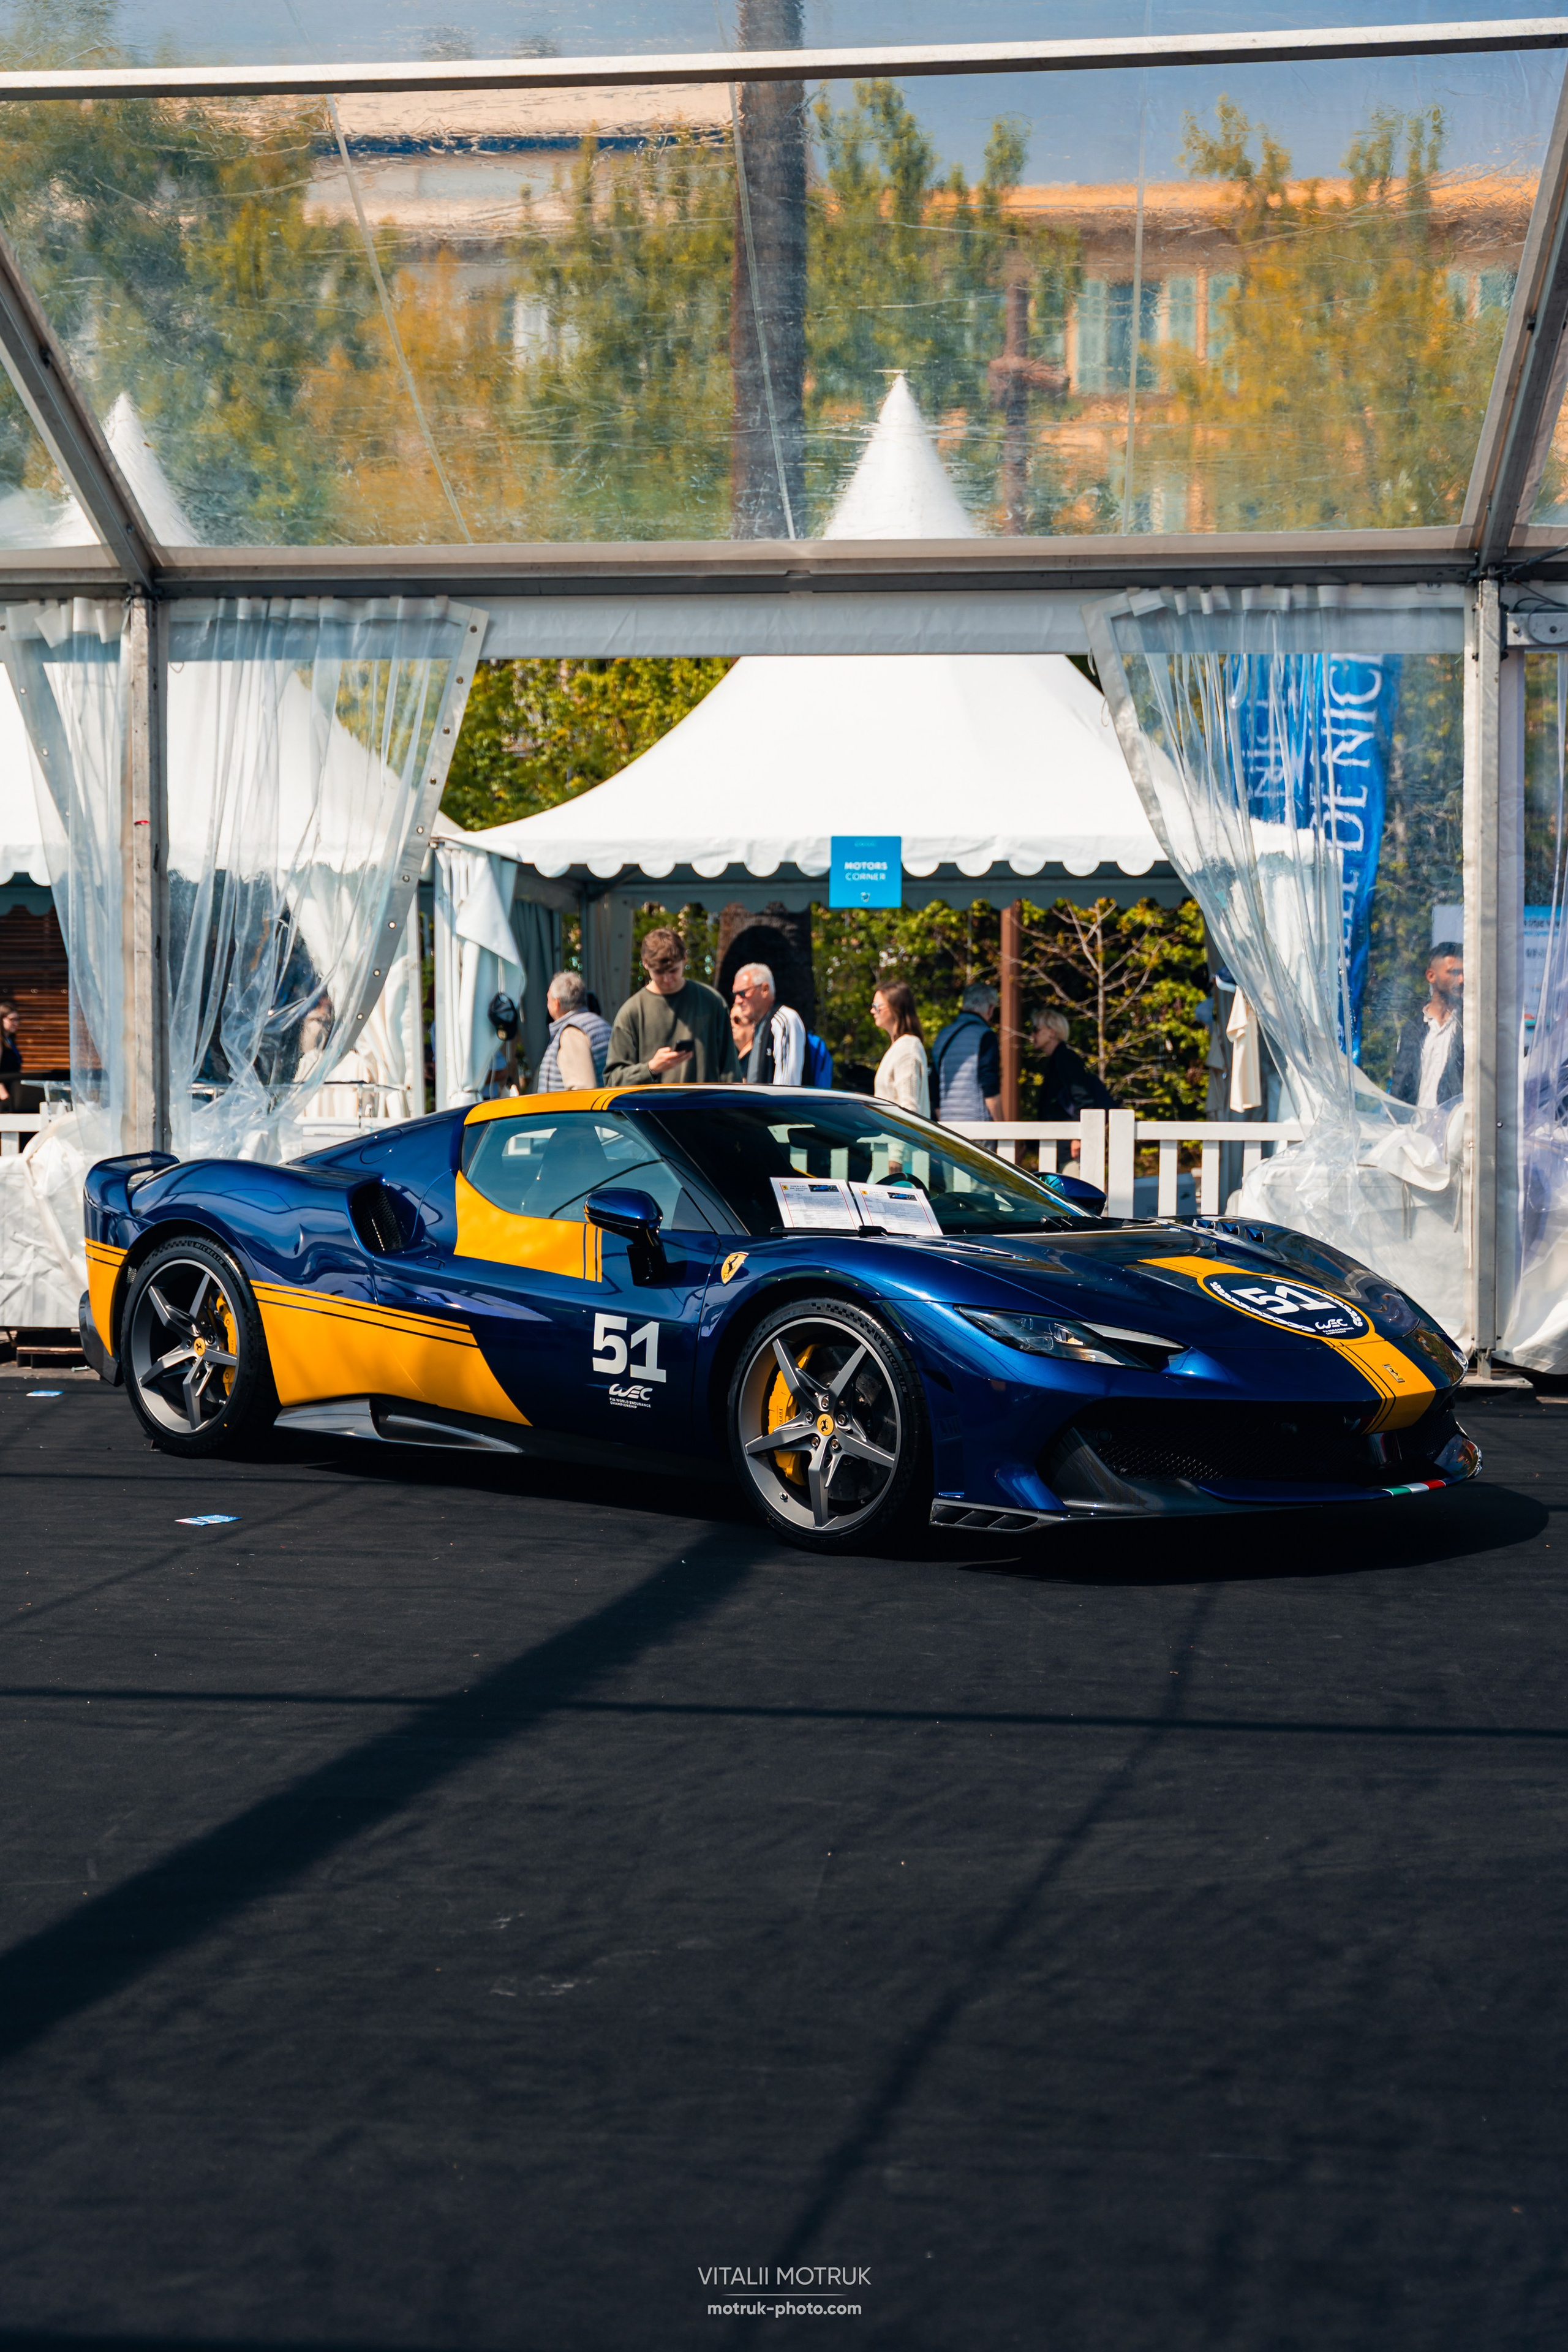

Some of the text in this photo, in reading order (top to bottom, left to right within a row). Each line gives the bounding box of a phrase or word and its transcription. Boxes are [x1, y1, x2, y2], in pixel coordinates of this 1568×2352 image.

[844, 861, 888, 870] MOTORS
[845, 872, 886, 881] CORNER
[194, 1242, 225, 1265] MICHELIN
[1231, 1285, 1337, 1314] 51
[1315, 1318, 1348, 1330] WEC
[592, 1313, 666, 1383] 51
[881, 1344, 908, 1393] MICHELIN
[609, 1384, 653, 1403] WEC
